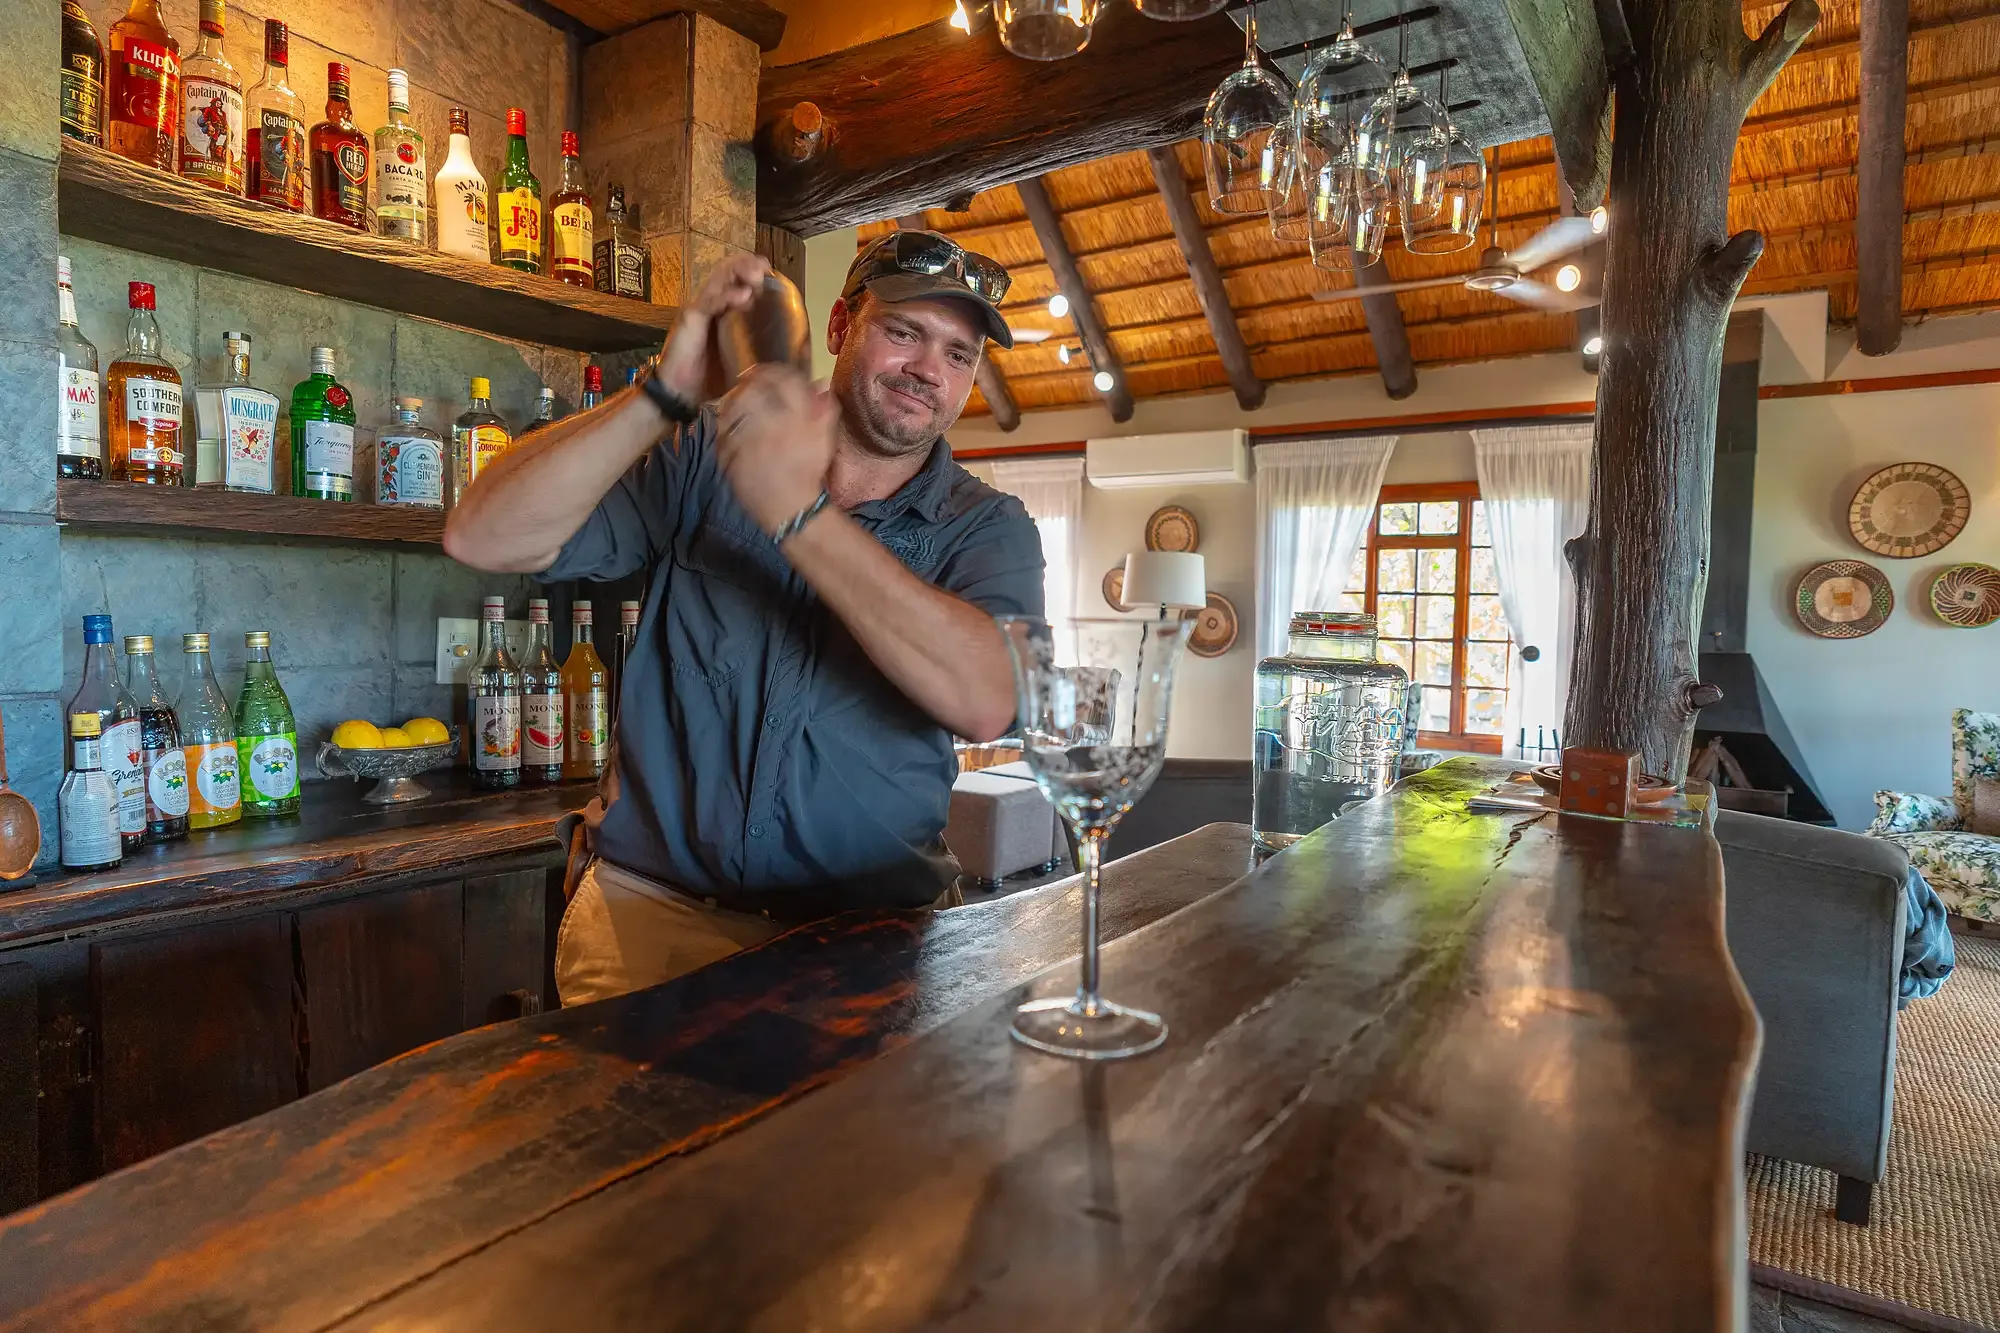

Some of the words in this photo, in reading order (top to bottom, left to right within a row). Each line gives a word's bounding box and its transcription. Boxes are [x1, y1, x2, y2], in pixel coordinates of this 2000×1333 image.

[187, 84, 216, 101] Captain
[263, 112, 292, 129] Captain
[345, 149, 365, 168] RED
[192, 161, 223, 173] SPICED
[345, 162, 364, 175] HEART
[385, 163, 425, 181] BACARD
[506, 206, 538, 241] J&B
[133, 388, 181, 404] SOUTHERN
[136, 399, 181, 416] COMFORT
[230, 396, 274, 423] MUSGRAVE
[416, 471, 431, 480] GIN
[483, 706, 520, 716] MONIN
[529, 703, 563, 713] MONIN
[575, 703, 608, 711] MONIN
